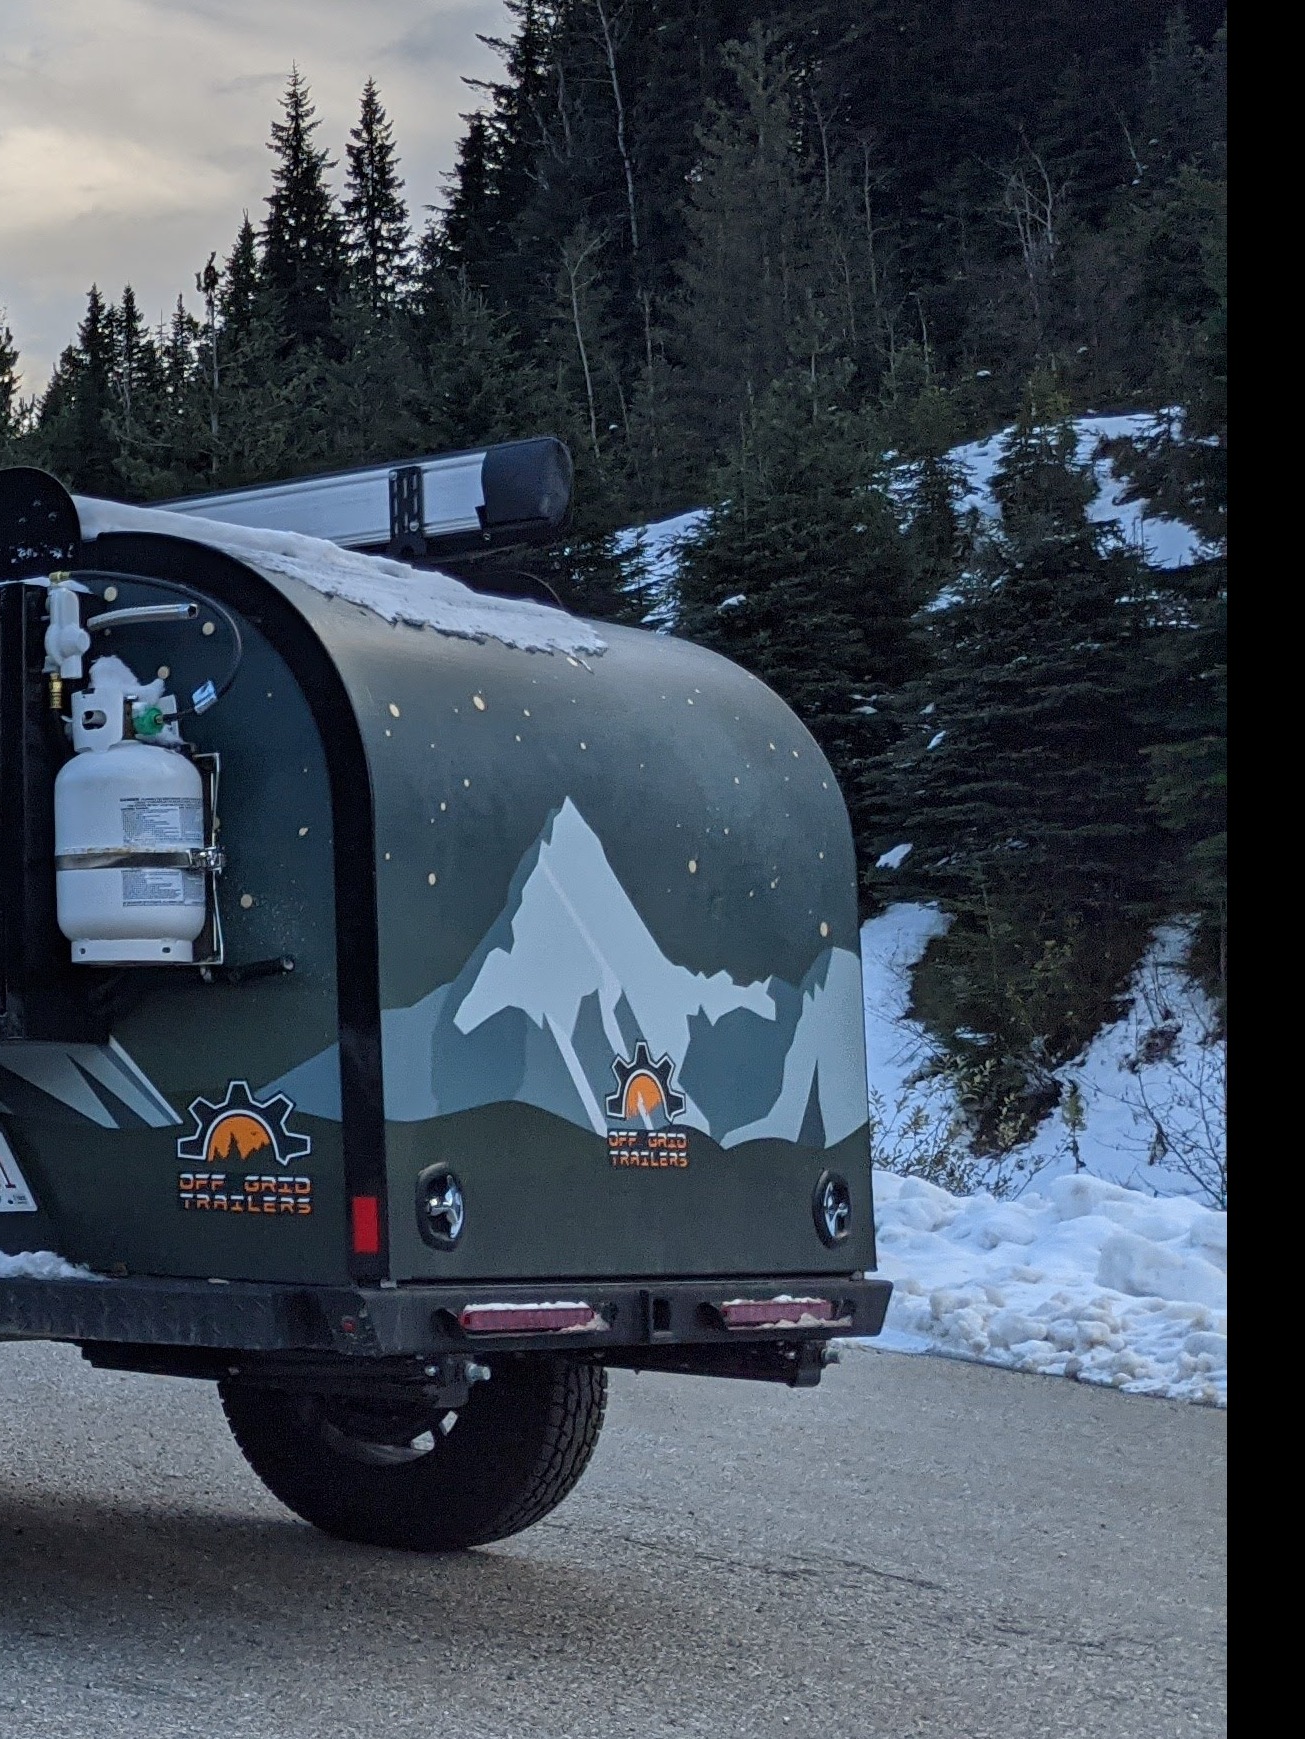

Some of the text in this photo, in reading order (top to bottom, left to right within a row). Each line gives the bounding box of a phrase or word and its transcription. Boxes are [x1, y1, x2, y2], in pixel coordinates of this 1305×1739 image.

[608, 1131, 687, 1149] OFF GRID
[609, 1150, 688, 1168] TRAILERS
[179, 1173, 312, 1195] OFF GRID
[179, 1192, 312, 1215] TRAILERS
